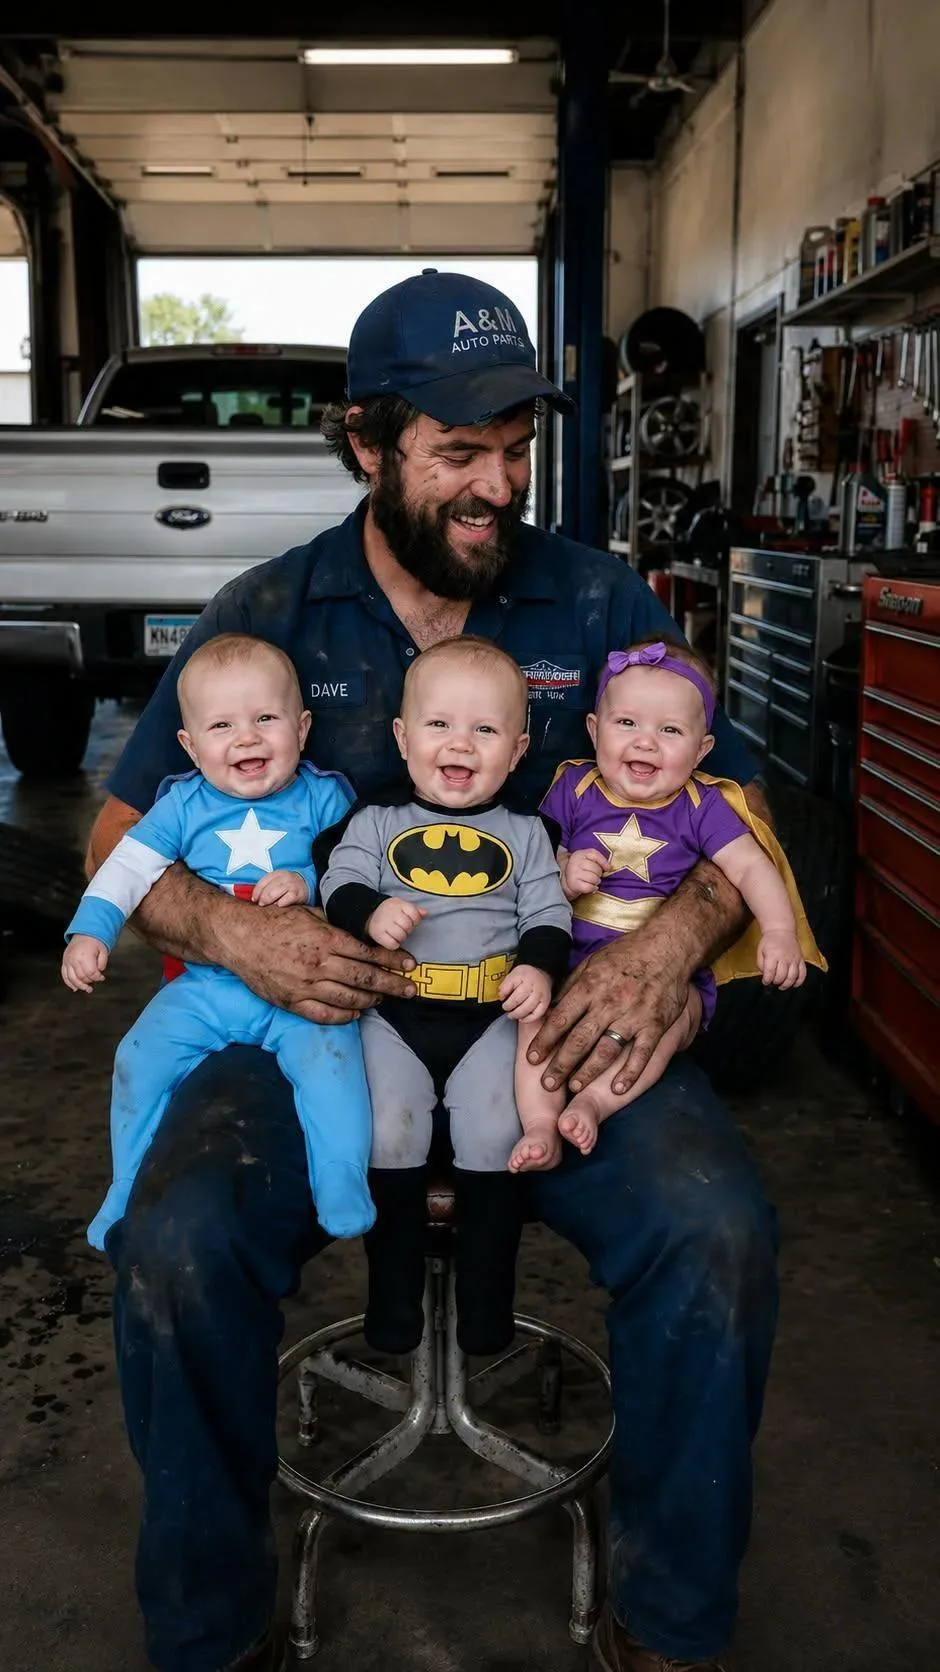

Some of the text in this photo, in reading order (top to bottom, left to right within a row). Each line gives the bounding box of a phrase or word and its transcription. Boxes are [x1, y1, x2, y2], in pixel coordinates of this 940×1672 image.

[453, 306, 517, 338] A&M
[451, 334, 525, 353] AUTO PARTS
[311, 682, 348, 698] DAVE
